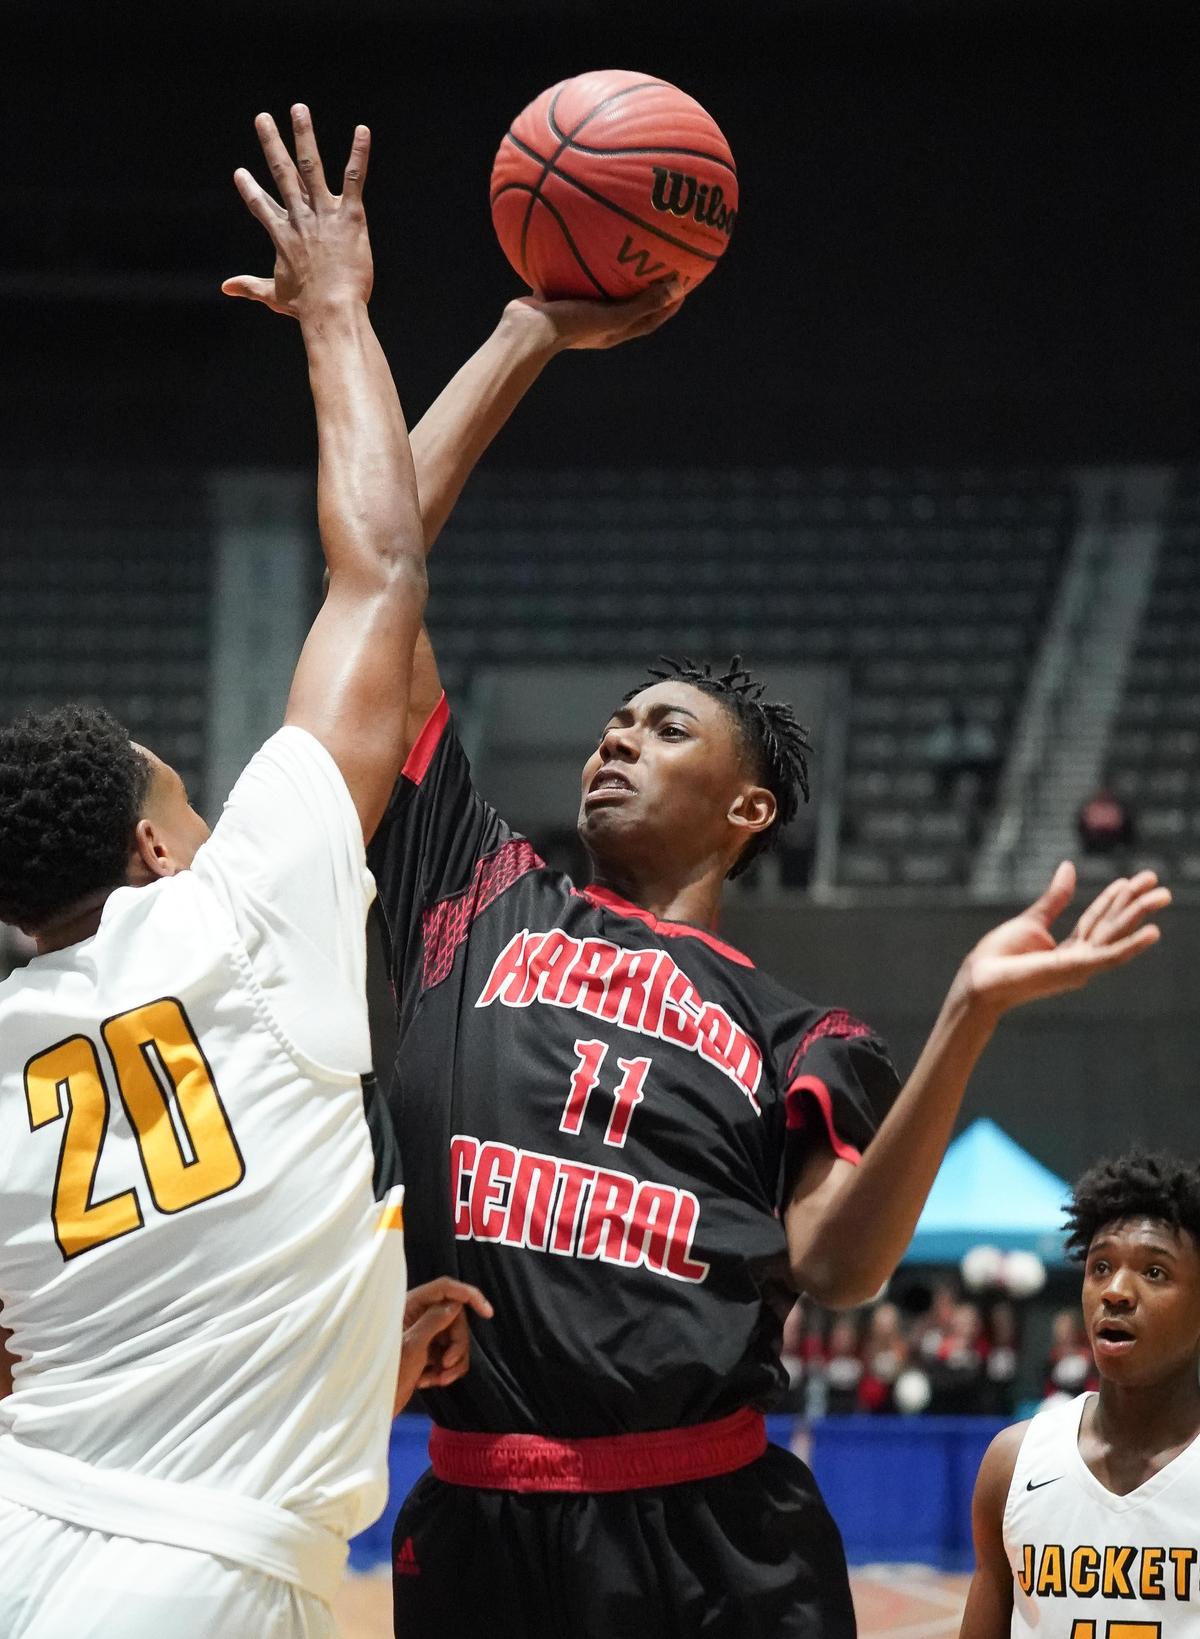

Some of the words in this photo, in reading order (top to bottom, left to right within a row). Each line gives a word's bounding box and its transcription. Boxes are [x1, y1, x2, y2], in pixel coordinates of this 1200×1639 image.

[475, 928, 763, 1116] HARRISON
[559, 1039, 652, 1148] 11
[23, 996, 246, 1262] 20
[450, 1135, 710, 1283] CENTRAL
[1018, 1544, 1200, 1601] JACKET
